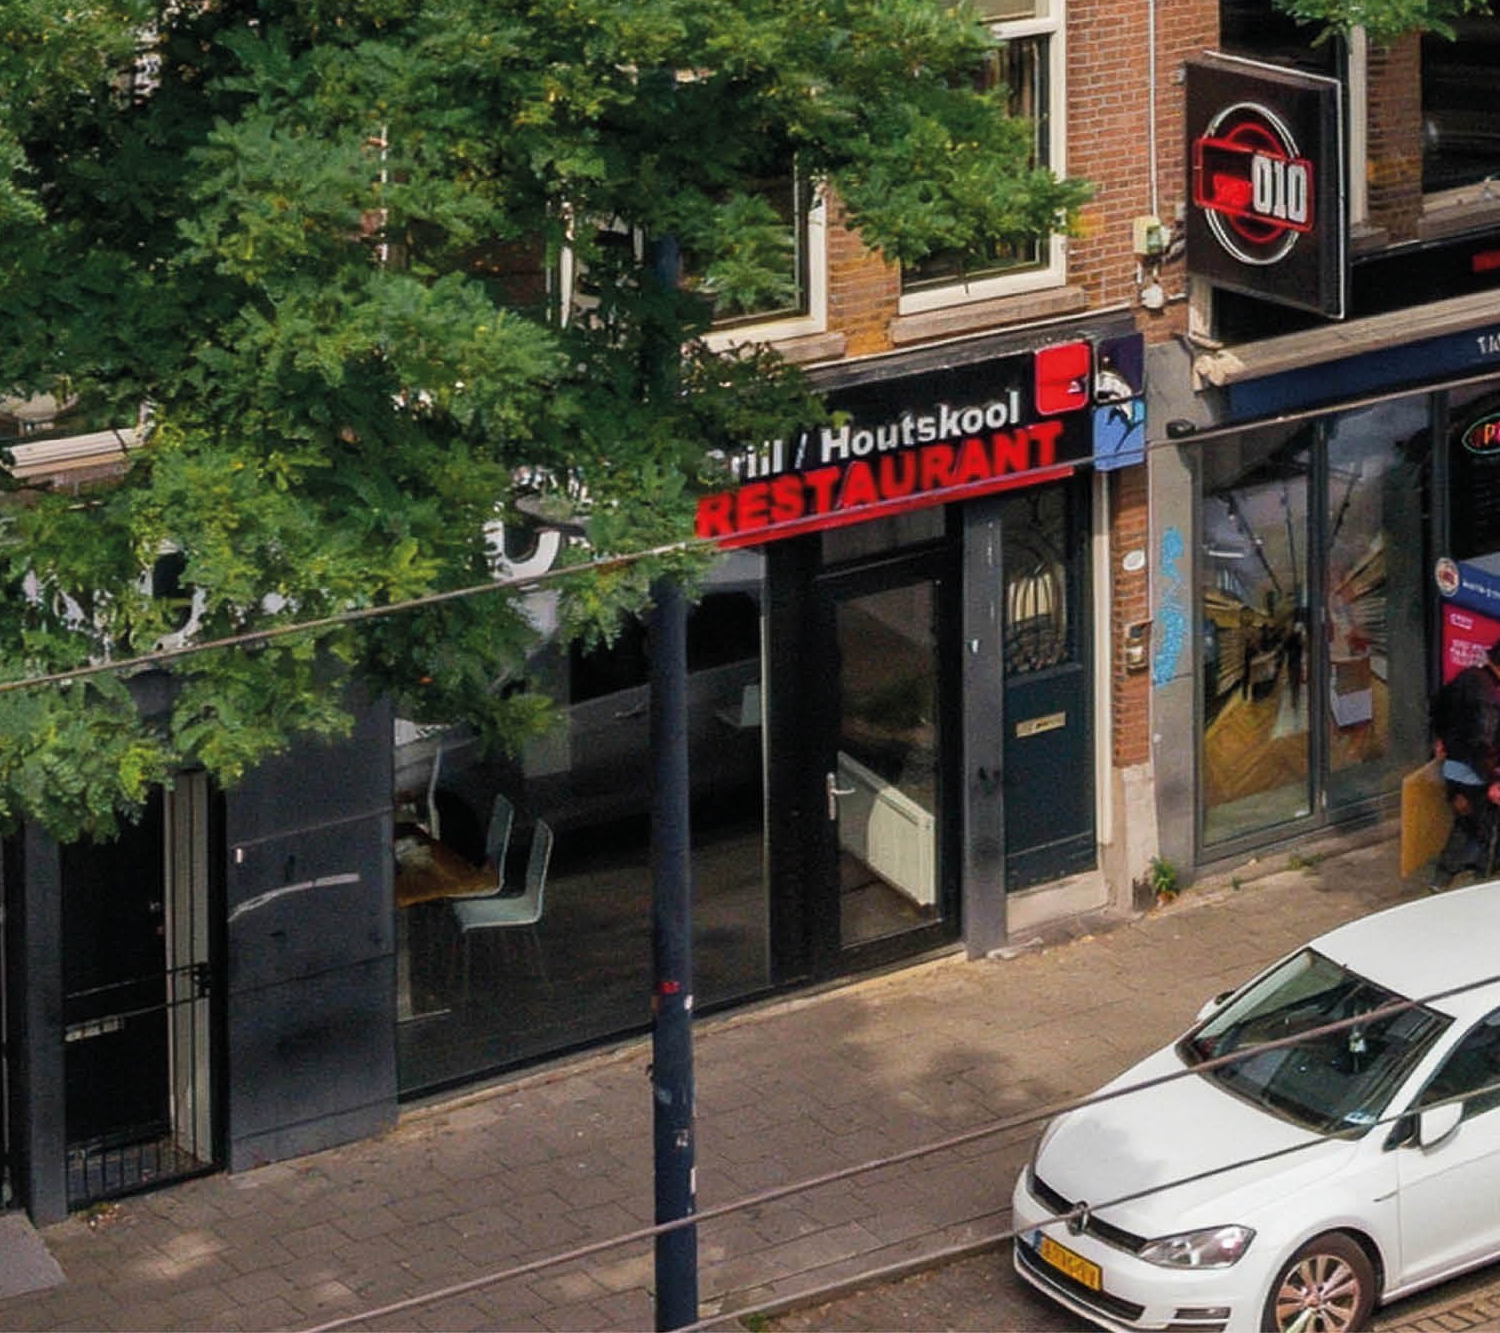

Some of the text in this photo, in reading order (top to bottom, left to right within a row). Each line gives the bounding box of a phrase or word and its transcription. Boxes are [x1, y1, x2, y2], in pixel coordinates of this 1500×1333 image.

[1252, 154, 1307, 223] 010
[820, 389, 1020, 464] Houtskool
[694, 419, 1063, 541] RESTAURANT
